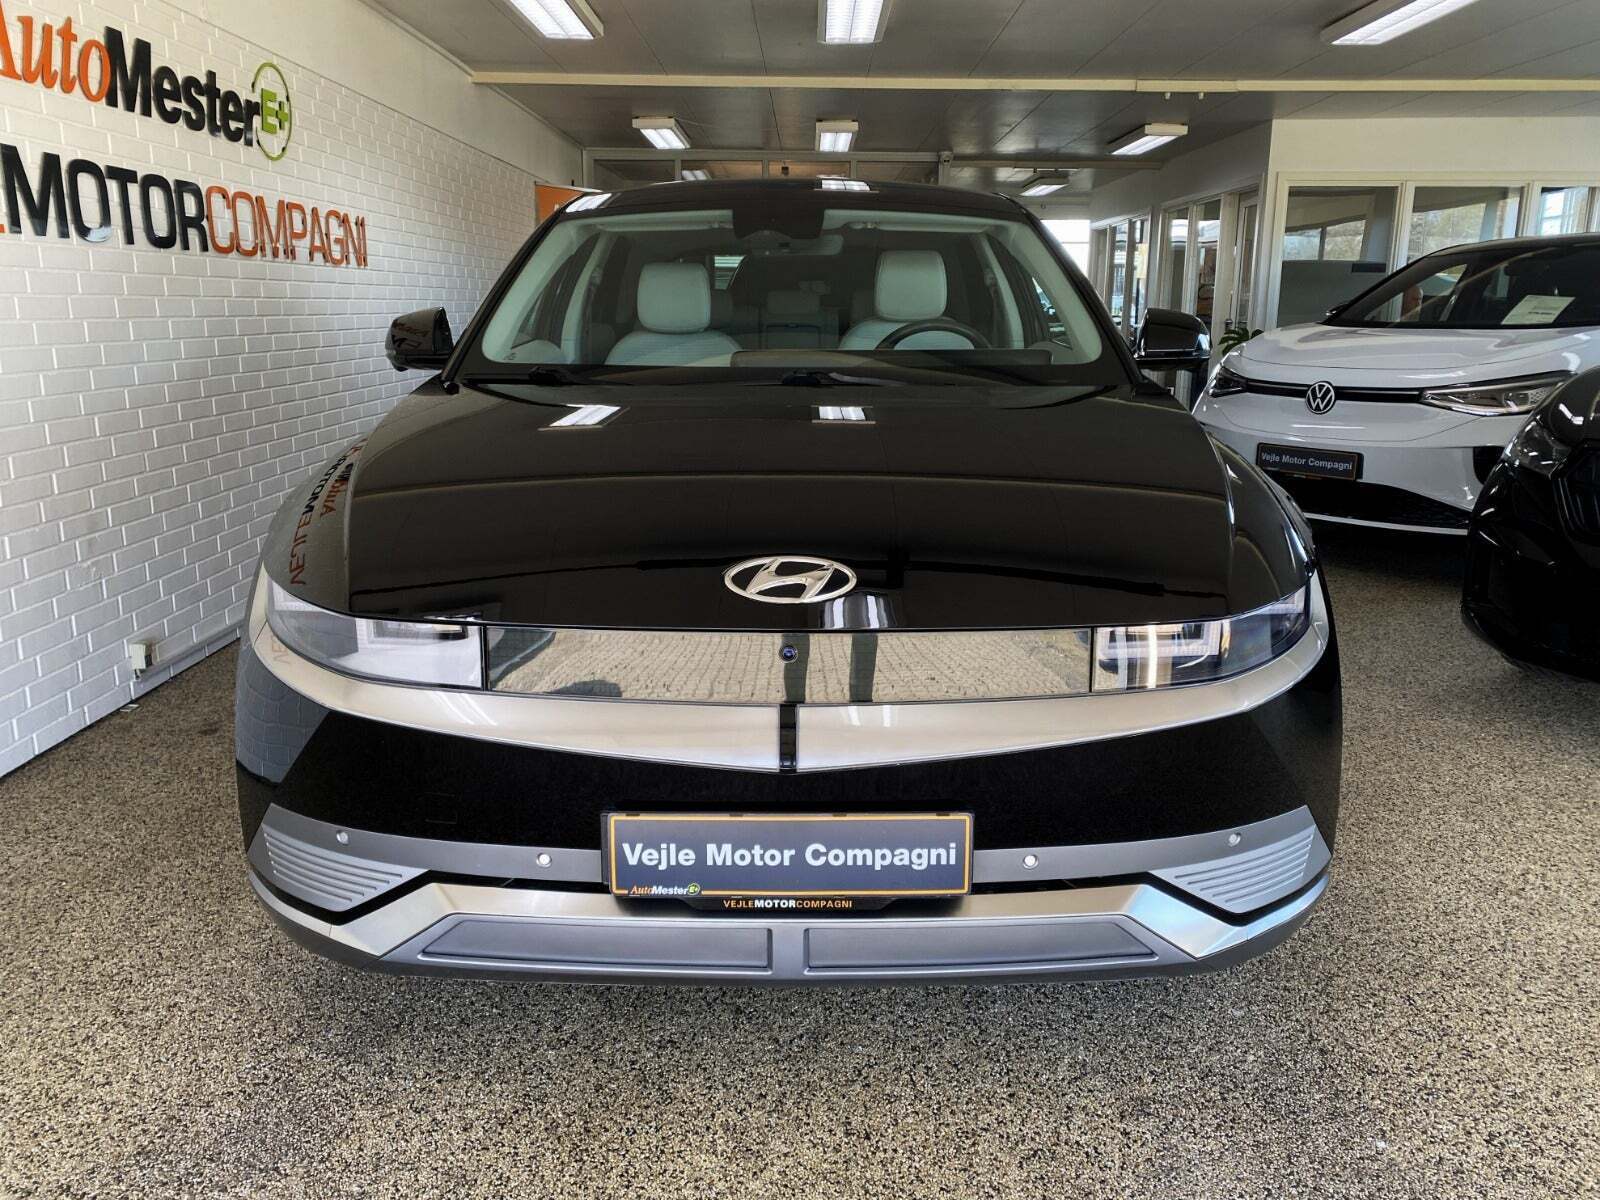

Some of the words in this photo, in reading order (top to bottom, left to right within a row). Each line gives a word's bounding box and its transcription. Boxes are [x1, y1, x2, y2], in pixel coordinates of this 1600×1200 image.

[0, 142, 369, 268] MOTORCOMPAGNI
[1262, 452, 1280, 462] Vejle
[1282, 455, 1306, 465] Motor
[1308, 458, 1352, 471] Compagni
[622, 842, 696, 871] Vejle
[706, 842, 796, 867] Motor
[804, 842, 956, 871] Compagni
[723, 899, 853, 909] VEJLEMOTORCOMPAGNI
